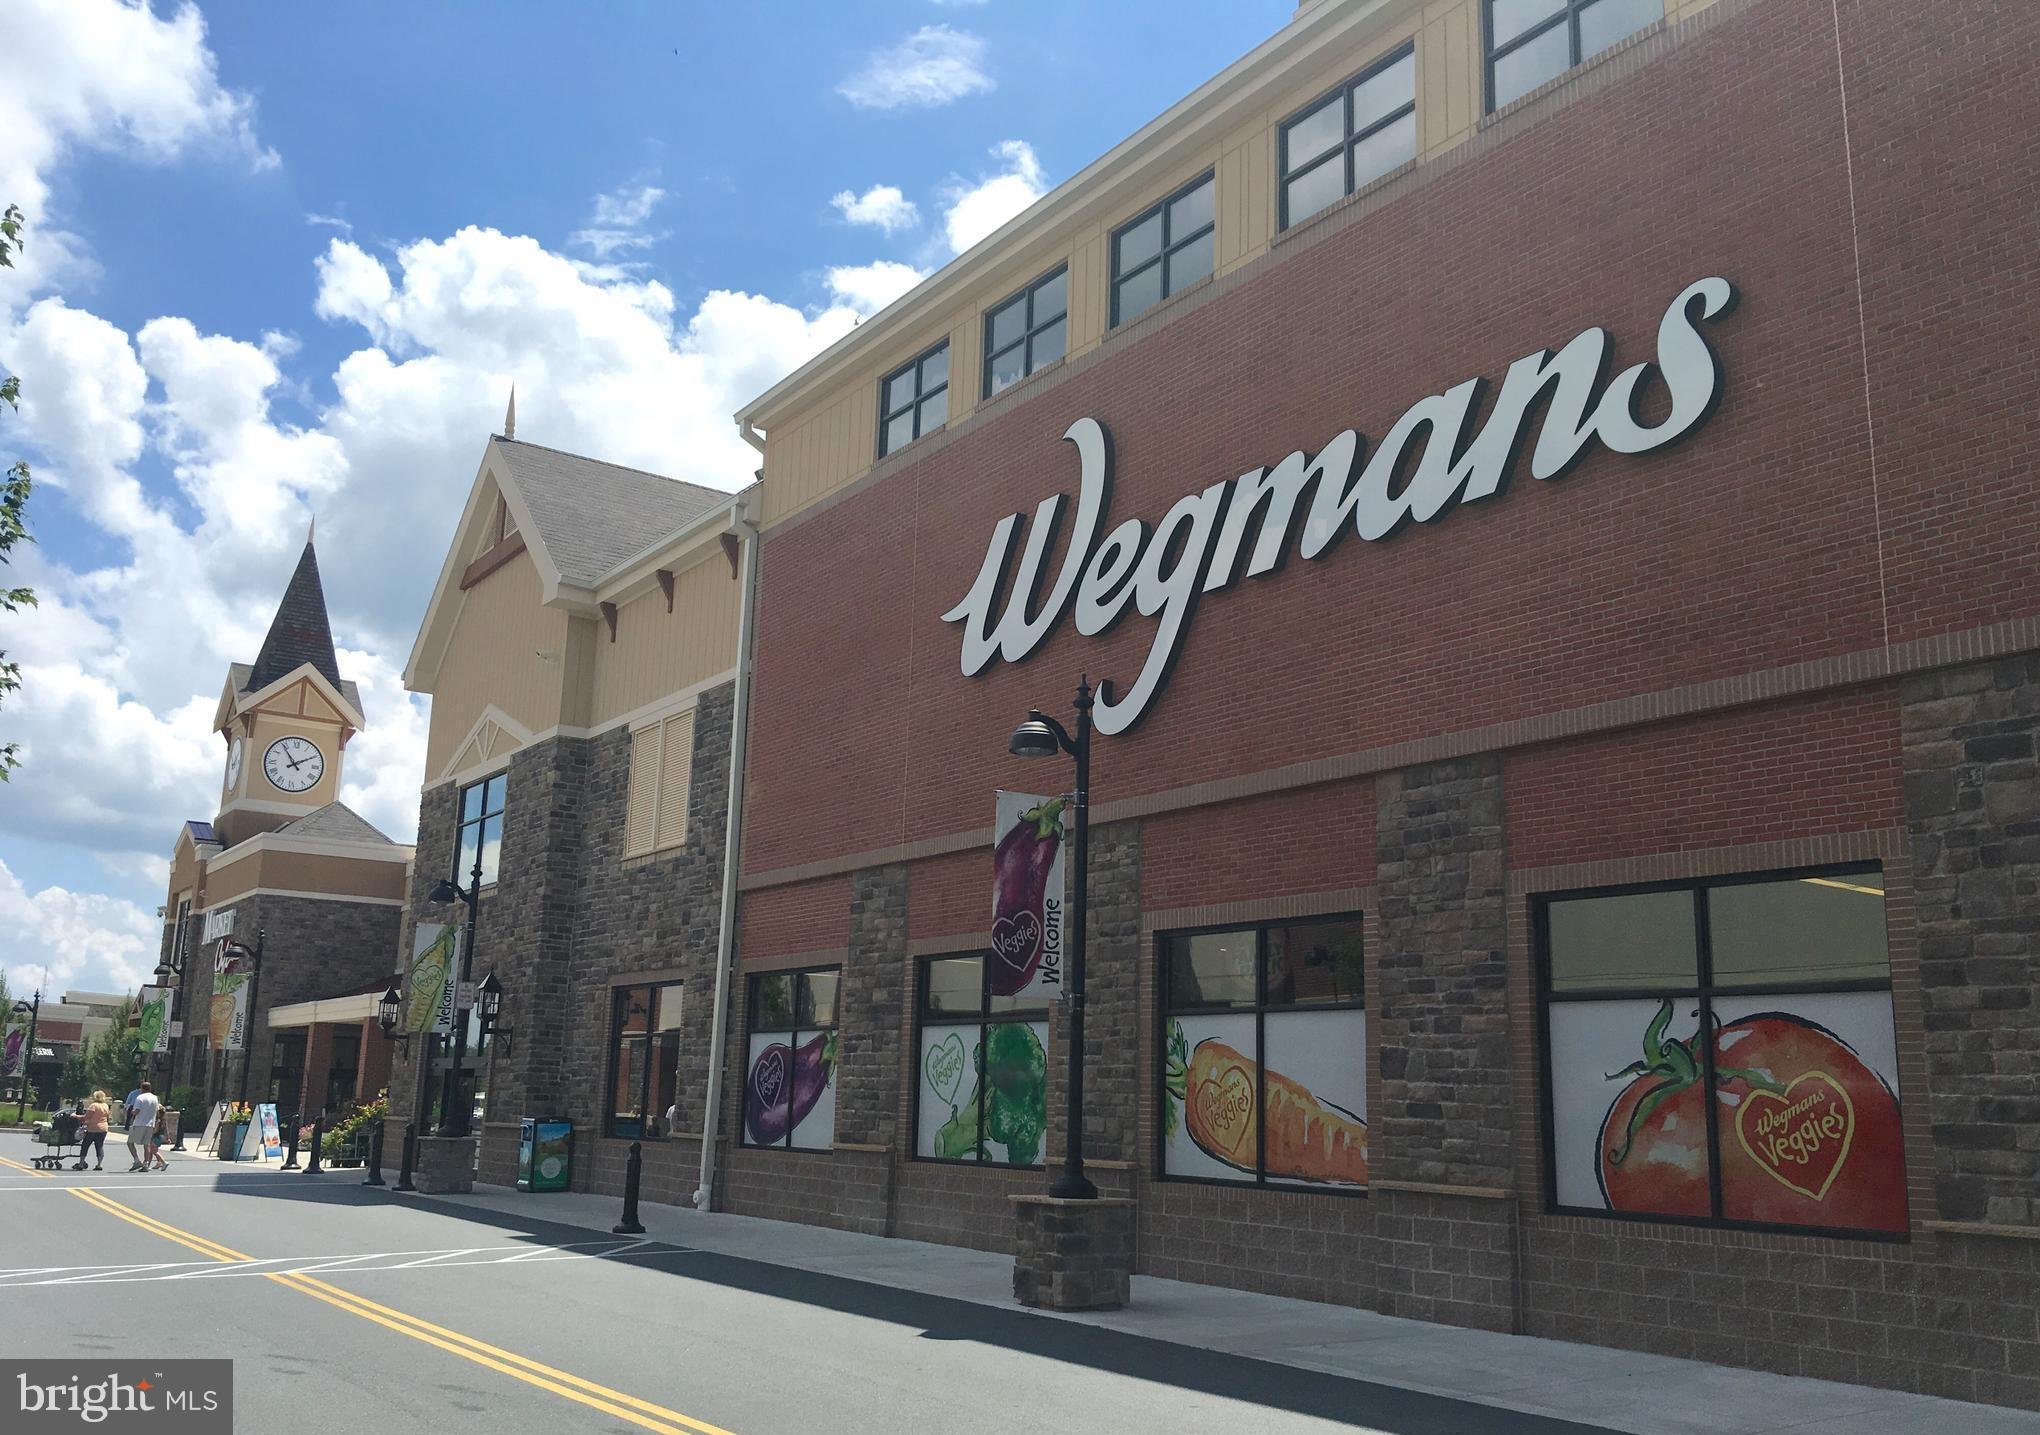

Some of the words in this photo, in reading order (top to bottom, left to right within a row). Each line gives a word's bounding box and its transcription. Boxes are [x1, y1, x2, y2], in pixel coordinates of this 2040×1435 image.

[941, 276, 1735, 736] Wegmans
[994, 920, 1038, 953] Veggies
[1037, 898, 1062, 985] Welcome
[436, 979, 454, 1025] Welcome
[230, 1012, 244, 1045] Welcome
[932, 1050, 962, 1087] Veggies
[1205, 1086, 1249, 1132] Veggies
[1754, 1088, 1825, 1136] Wegmans
[1757, 1102, 1845, 1167] Veggies
